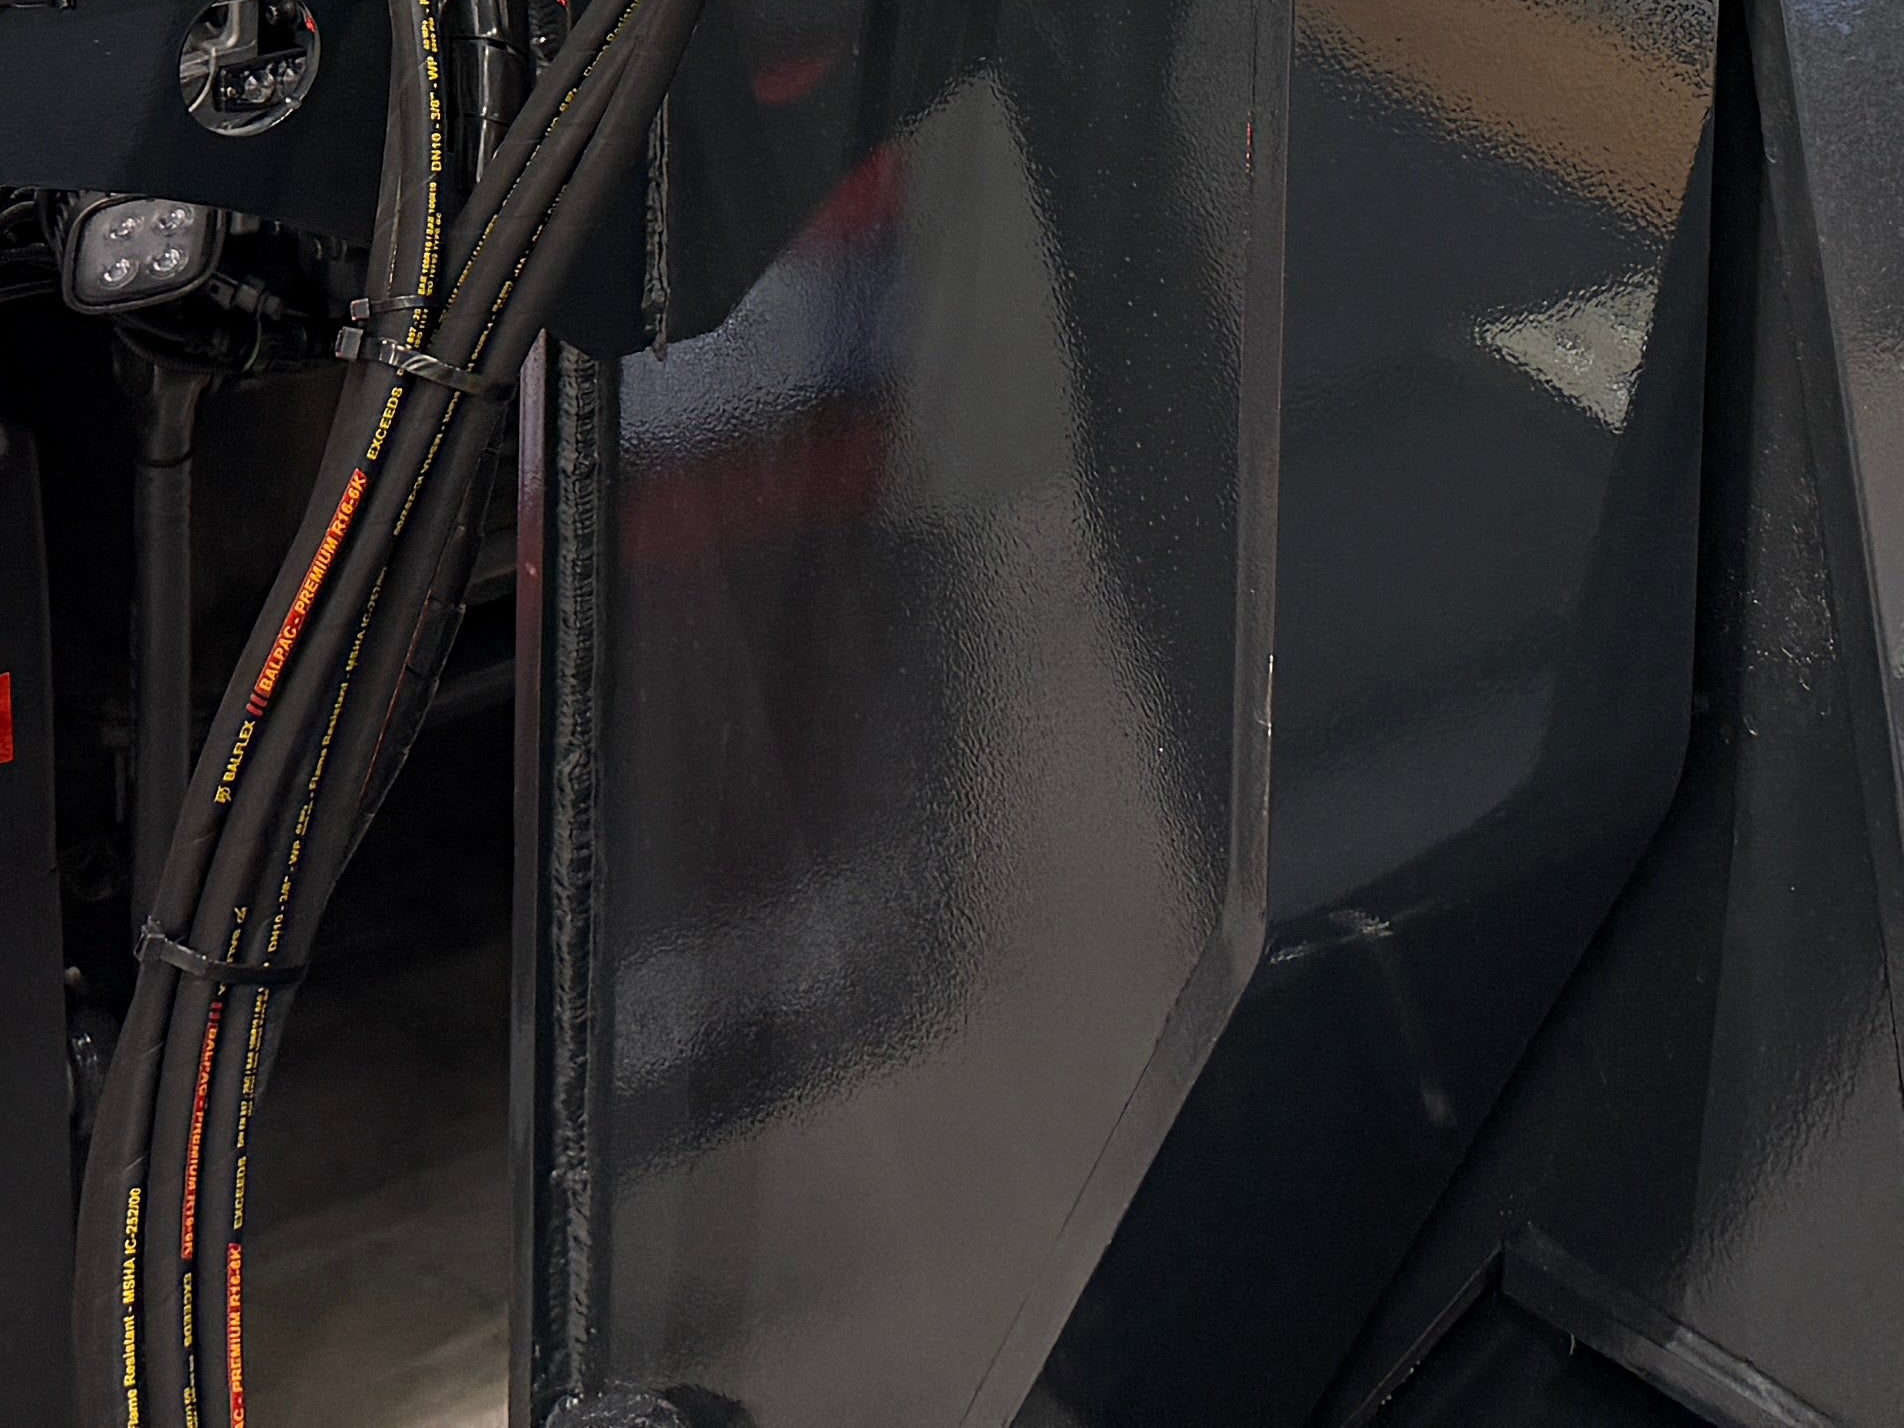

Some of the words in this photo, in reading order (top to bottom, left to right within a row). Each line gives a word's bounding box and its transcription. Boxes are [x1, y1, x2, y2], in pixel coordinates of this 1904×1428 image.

[430, 133, 442, 172] DN10
[366, 386, 403, 460] EXCEEDS
[259, 624, 297, 693] BALPAC
[294, 535, 337, 615] PREMIUM
[222, 720, 256, 783] BALFLEX
[124, 1187, 143, 1255] IC-252/00
[122, 1256, 136, 1305] MSHA
[229, 1306, 245, 1393] PREMIUM
